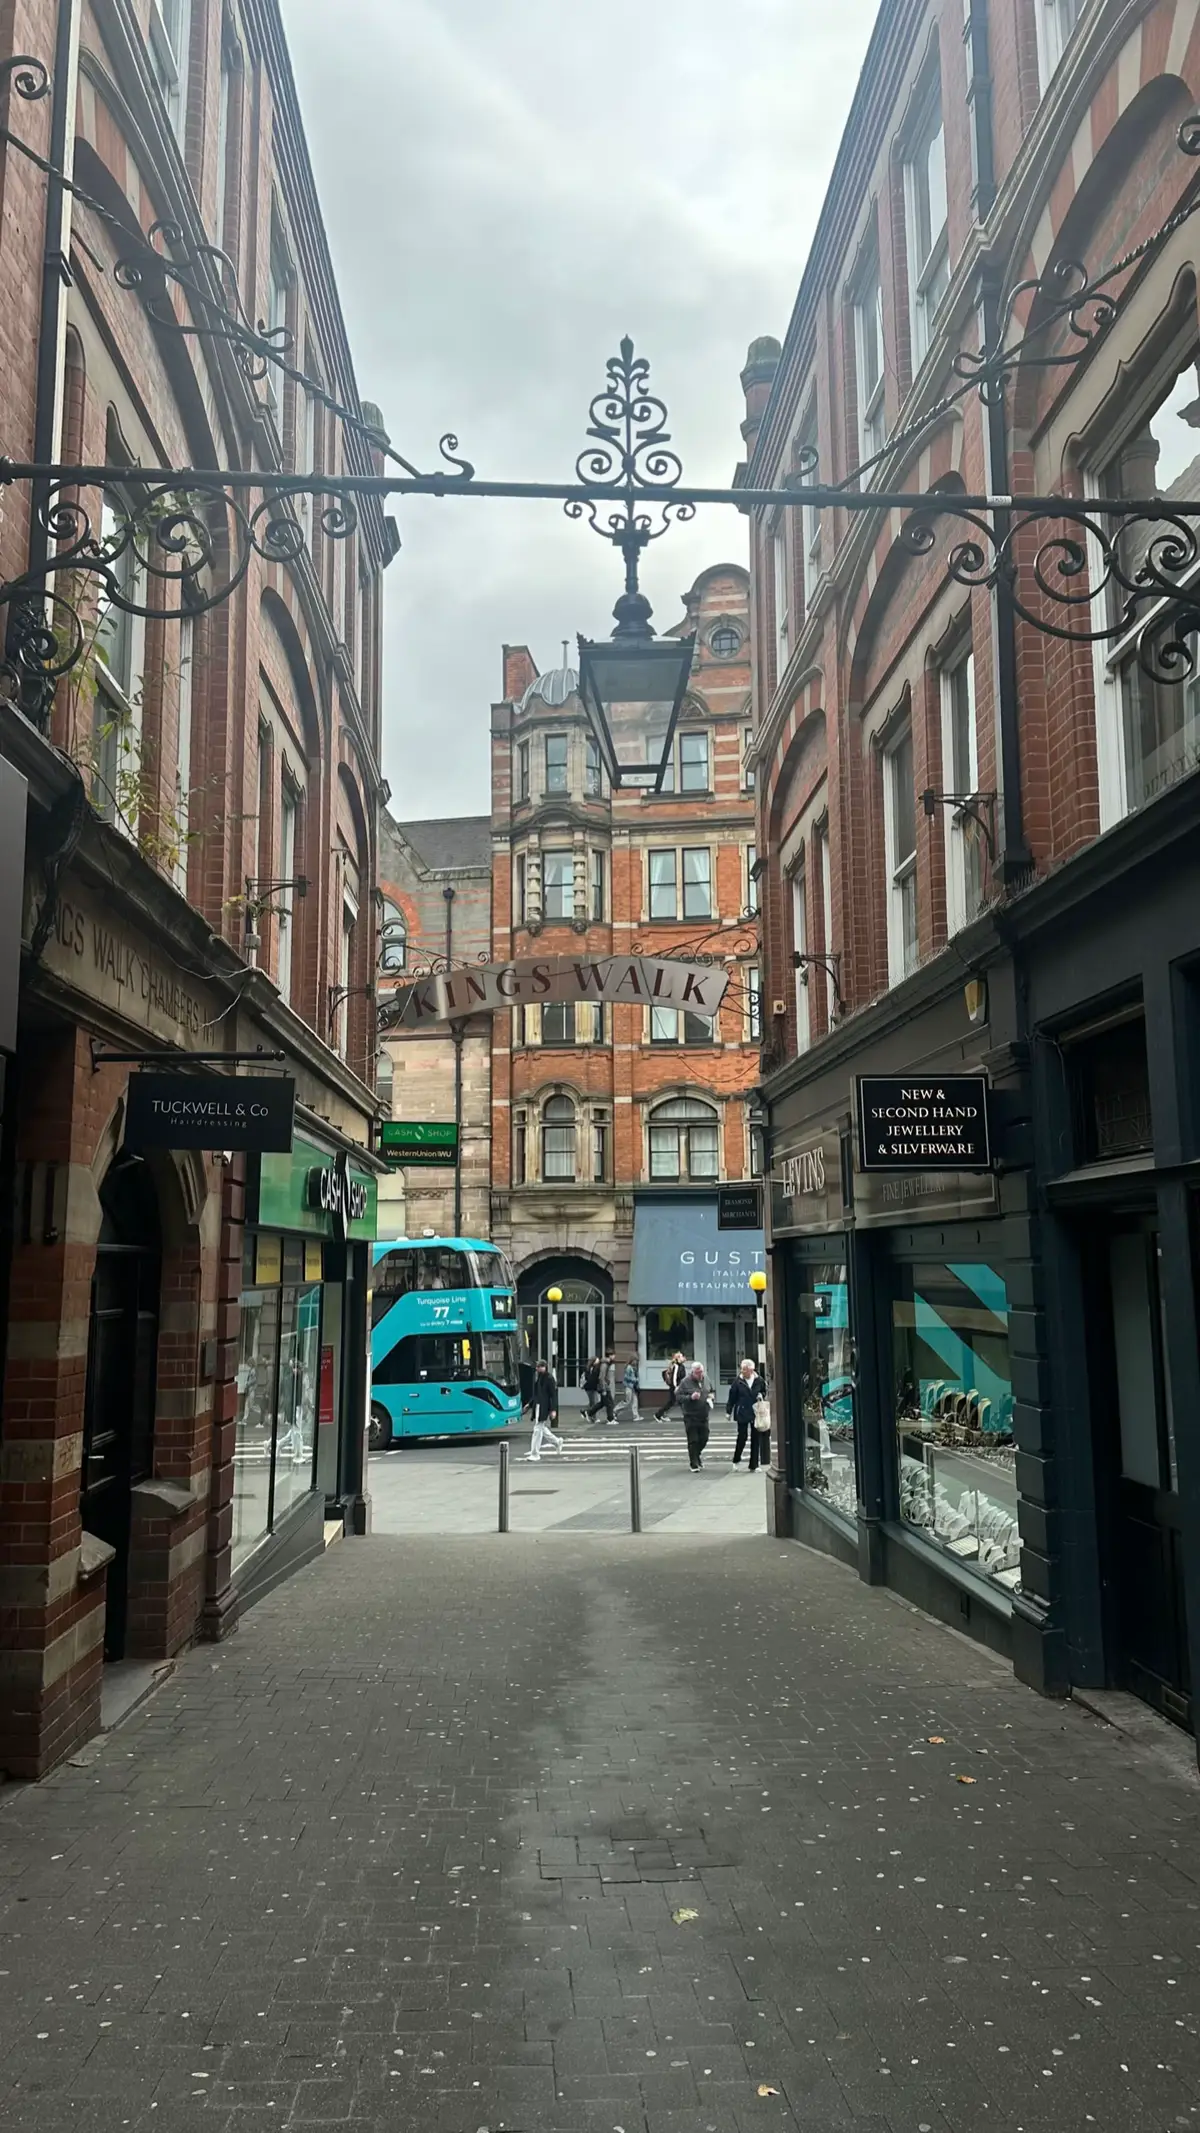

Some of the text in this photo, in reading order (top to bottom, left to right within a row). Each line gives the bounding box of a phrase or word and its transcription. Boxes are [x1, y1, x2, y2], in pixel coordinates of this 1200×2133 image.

[93, 923, 135, 993] WALK
[412, 962, 710, 1019] KINGS WALK
[901, 1088, 946, 1100] NEW &
[151, 1100, 269, 1117] TUCKWELL & Co
[871, 1107, 978, 1119] SECOND HAND
[170, 1117, 248, 1129] Hairdressing
[886, 1125, 964, 1137] JEWELLERY
[878, 1143, 975, 1155] & SILVERWARE
[780, 1146, 825, 1199] LEVINS
[320, 1167, 342, 1215] CASH
[882, 1181, 900, 1203] FINE
[416, 1296, 467, 1306] Turquoise Line
[433, 1306, 450, 1319] 77
